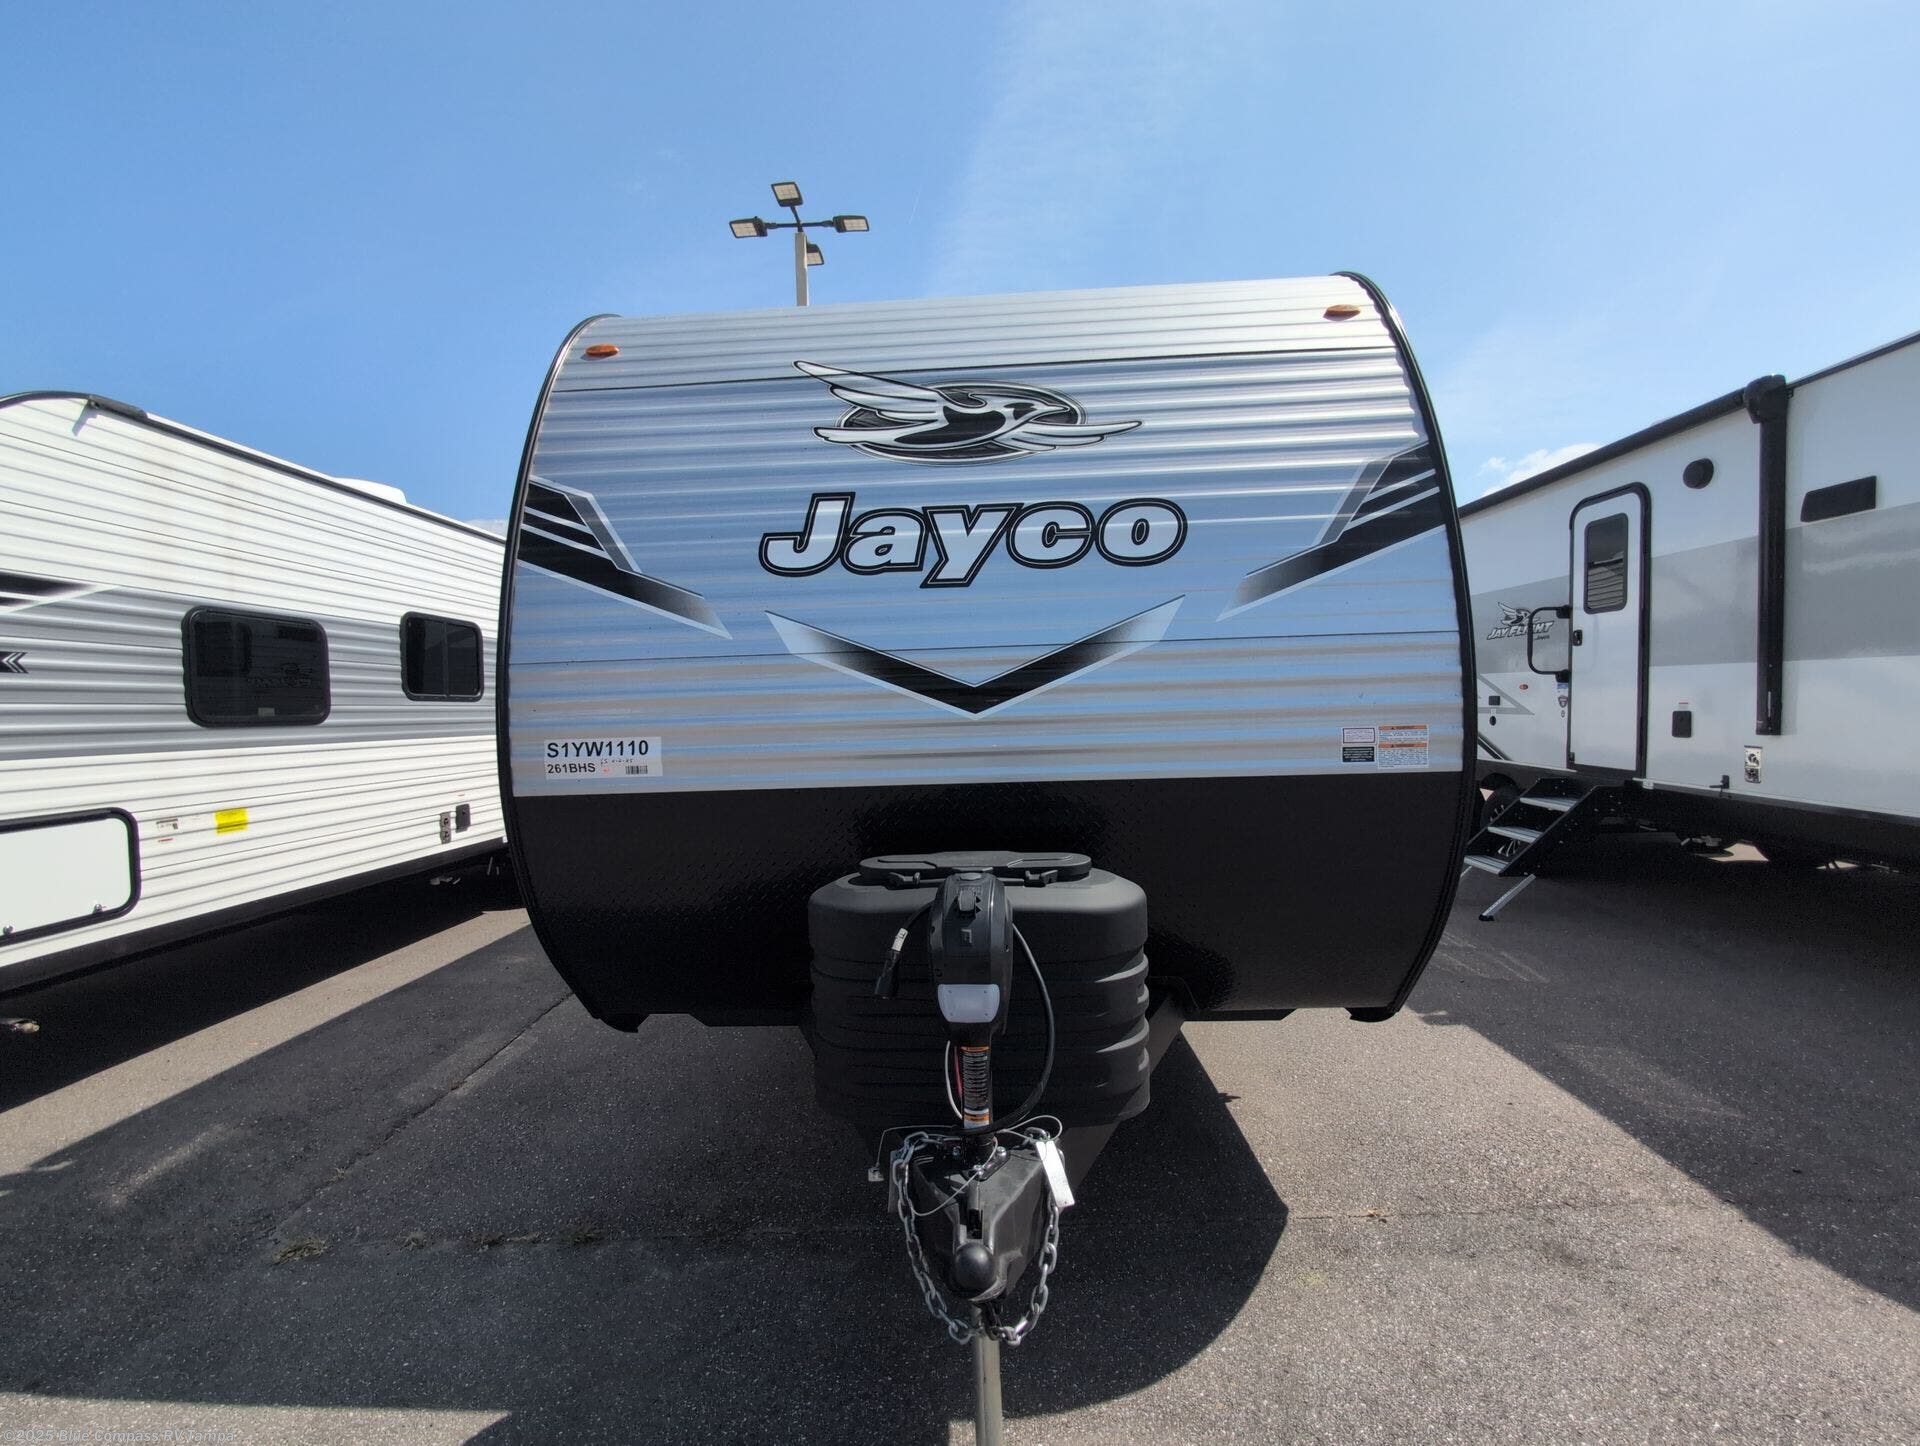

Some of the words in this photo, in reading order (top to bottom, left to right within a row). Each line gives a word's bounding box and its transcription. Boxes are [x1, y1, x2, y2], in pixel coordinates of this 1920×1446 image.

[759, 491, 1188, 588] Jayco
[1486, 626, 1511, 640] JAY
[1507, 620, 1555, 637] FLIHT
[547, 740, 649, 758] S1YW1110
[547, 762, 596, 774] 261BHS
